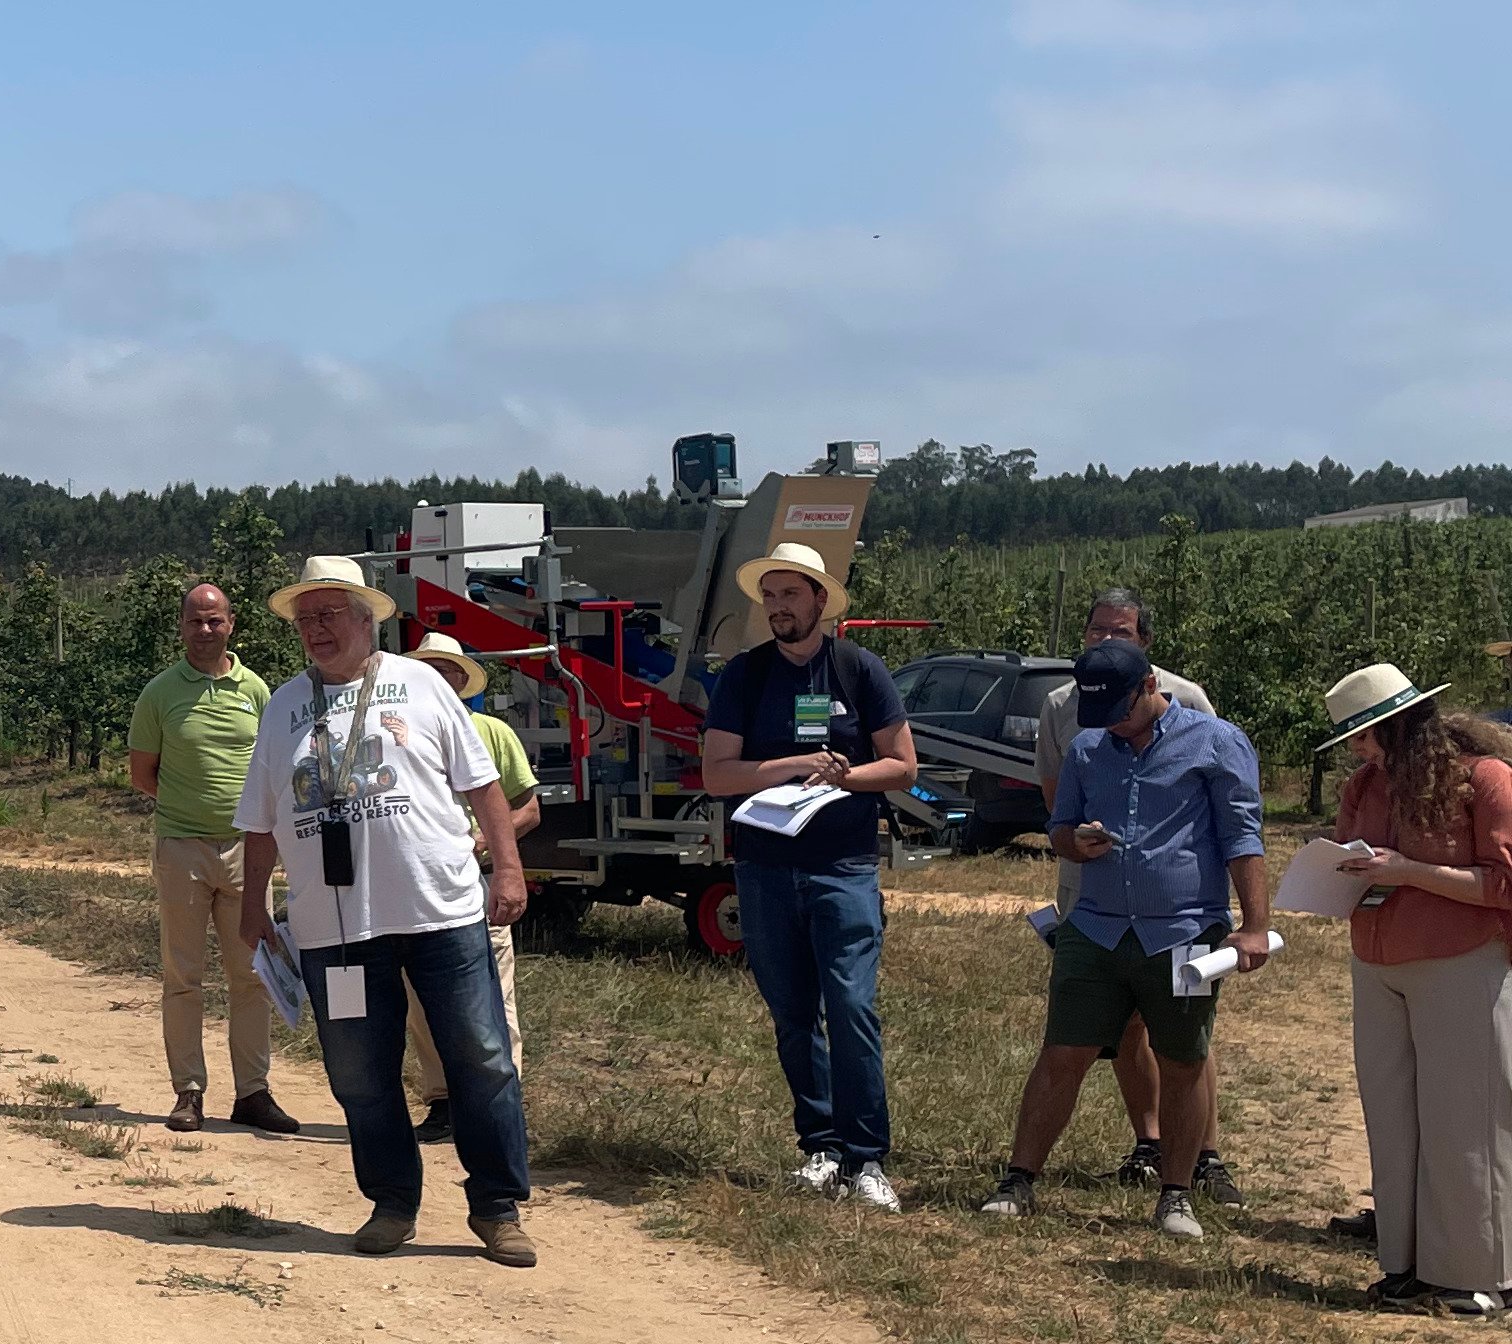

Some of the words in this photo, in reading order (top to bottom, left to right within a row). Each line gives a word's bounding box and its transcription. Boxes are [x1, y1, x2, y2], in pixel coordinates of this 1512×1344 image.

[290, 710, 298, 728] A
[301, 683, 408, 720] AGICUURA
[316, 811, 325, 823] O
[351, 811, 363, 823] O
[366, 804, 410, 820] RESTO
